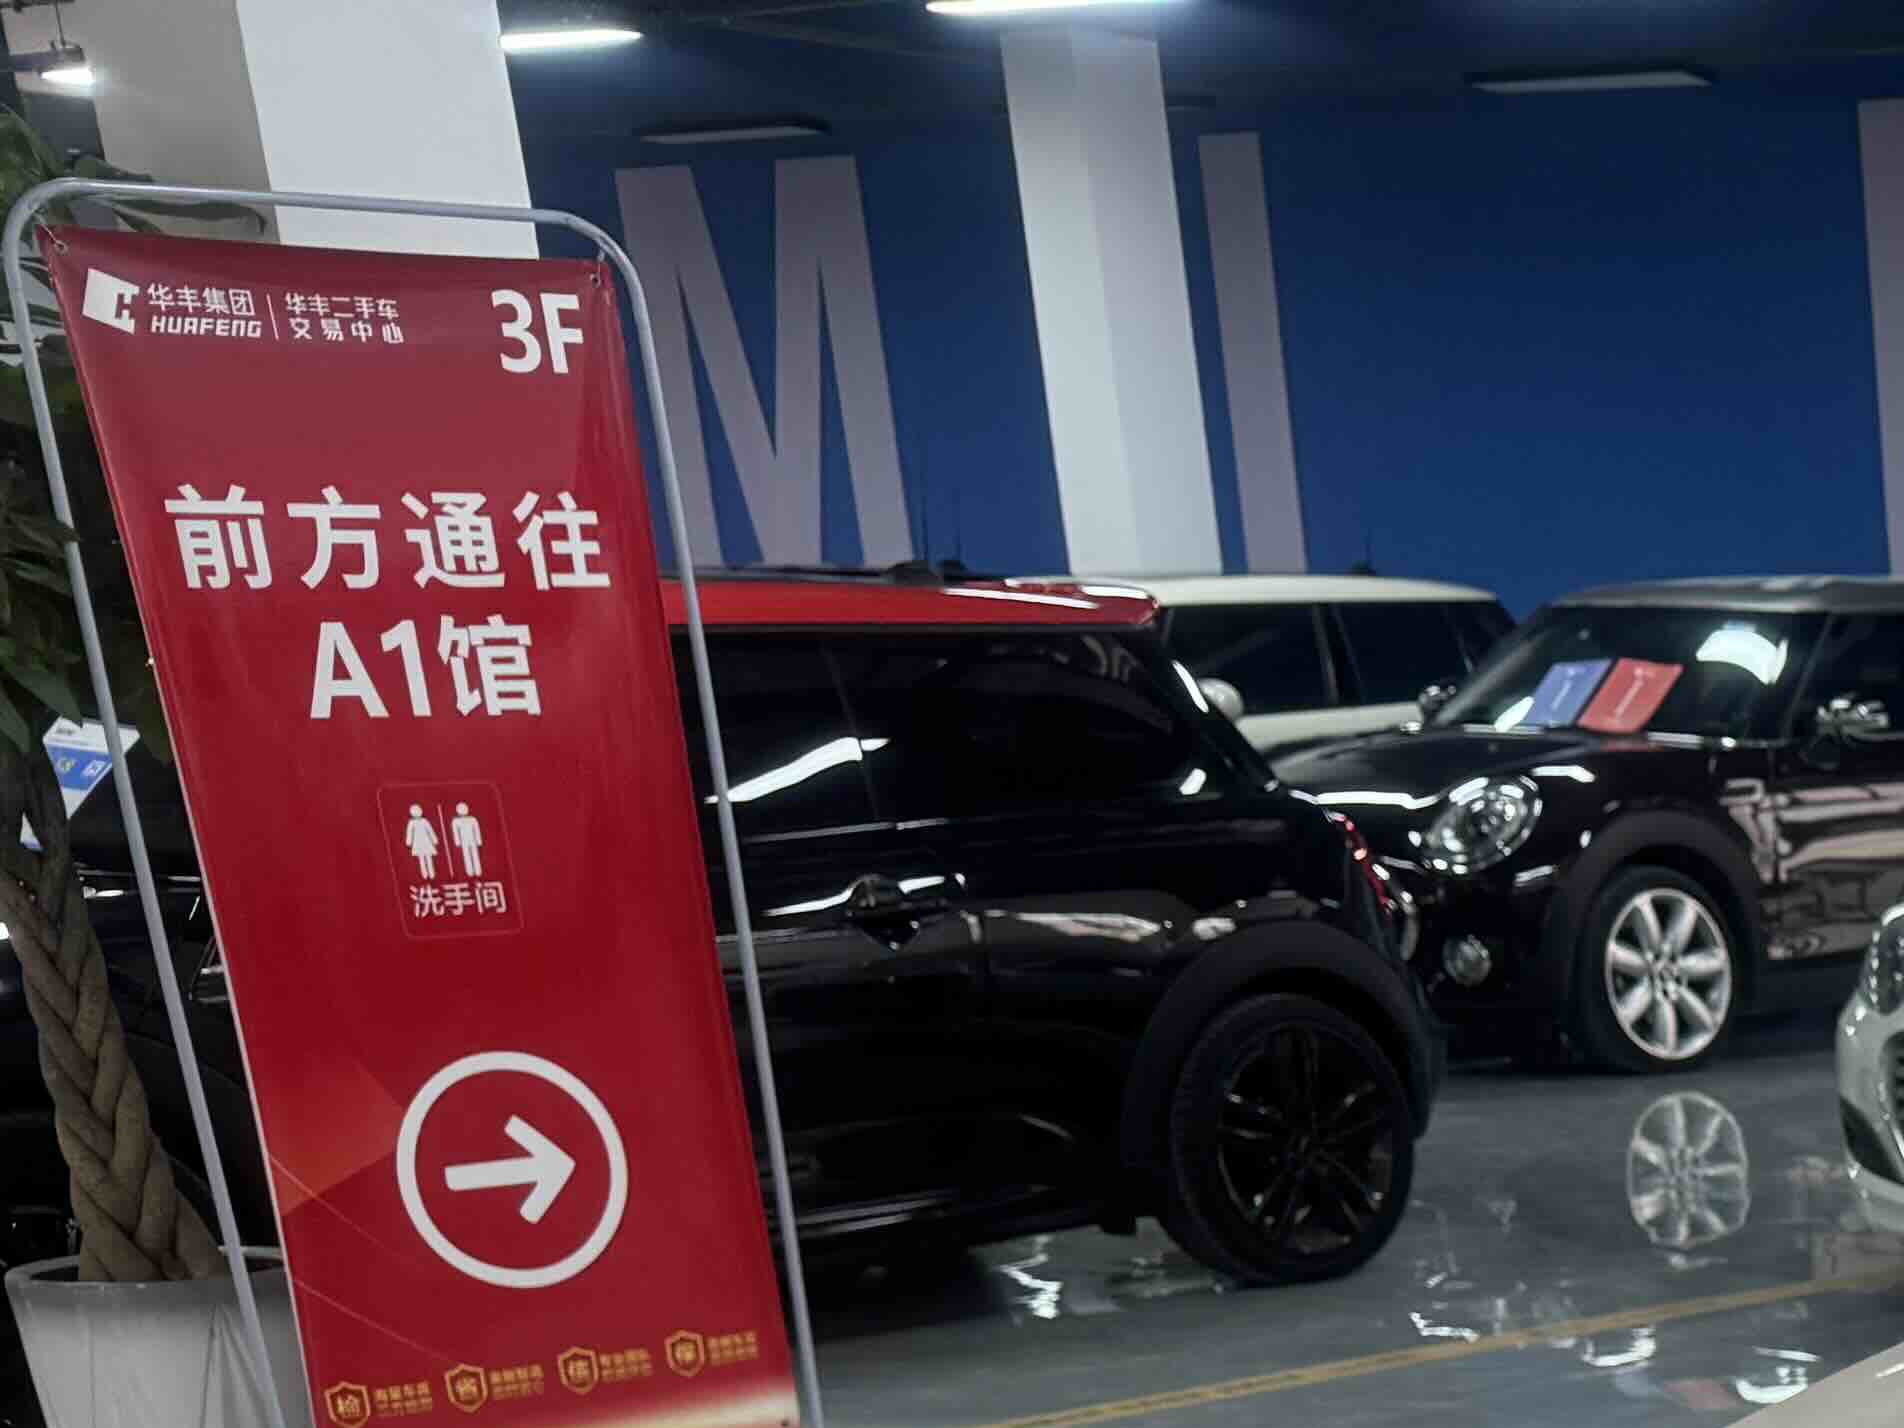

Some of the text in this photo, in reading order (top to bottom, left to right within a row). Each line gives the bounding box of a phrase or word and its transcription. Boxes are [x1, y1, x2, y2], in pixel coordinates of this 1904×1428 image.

[147, 284, 256, 317] 华丰集团
[285, 292, 399, 320] 华丰二手车
[151, 315, 262, 338] HUAFENG
[289, 318, 405, 344] 交易中心
[491, 289, 585, 375] 3F
[164, 485, 611, 591] 前方通往
[309, 615, 542, 721] A1馆
[409, 881, 507, 918] 洗手间
